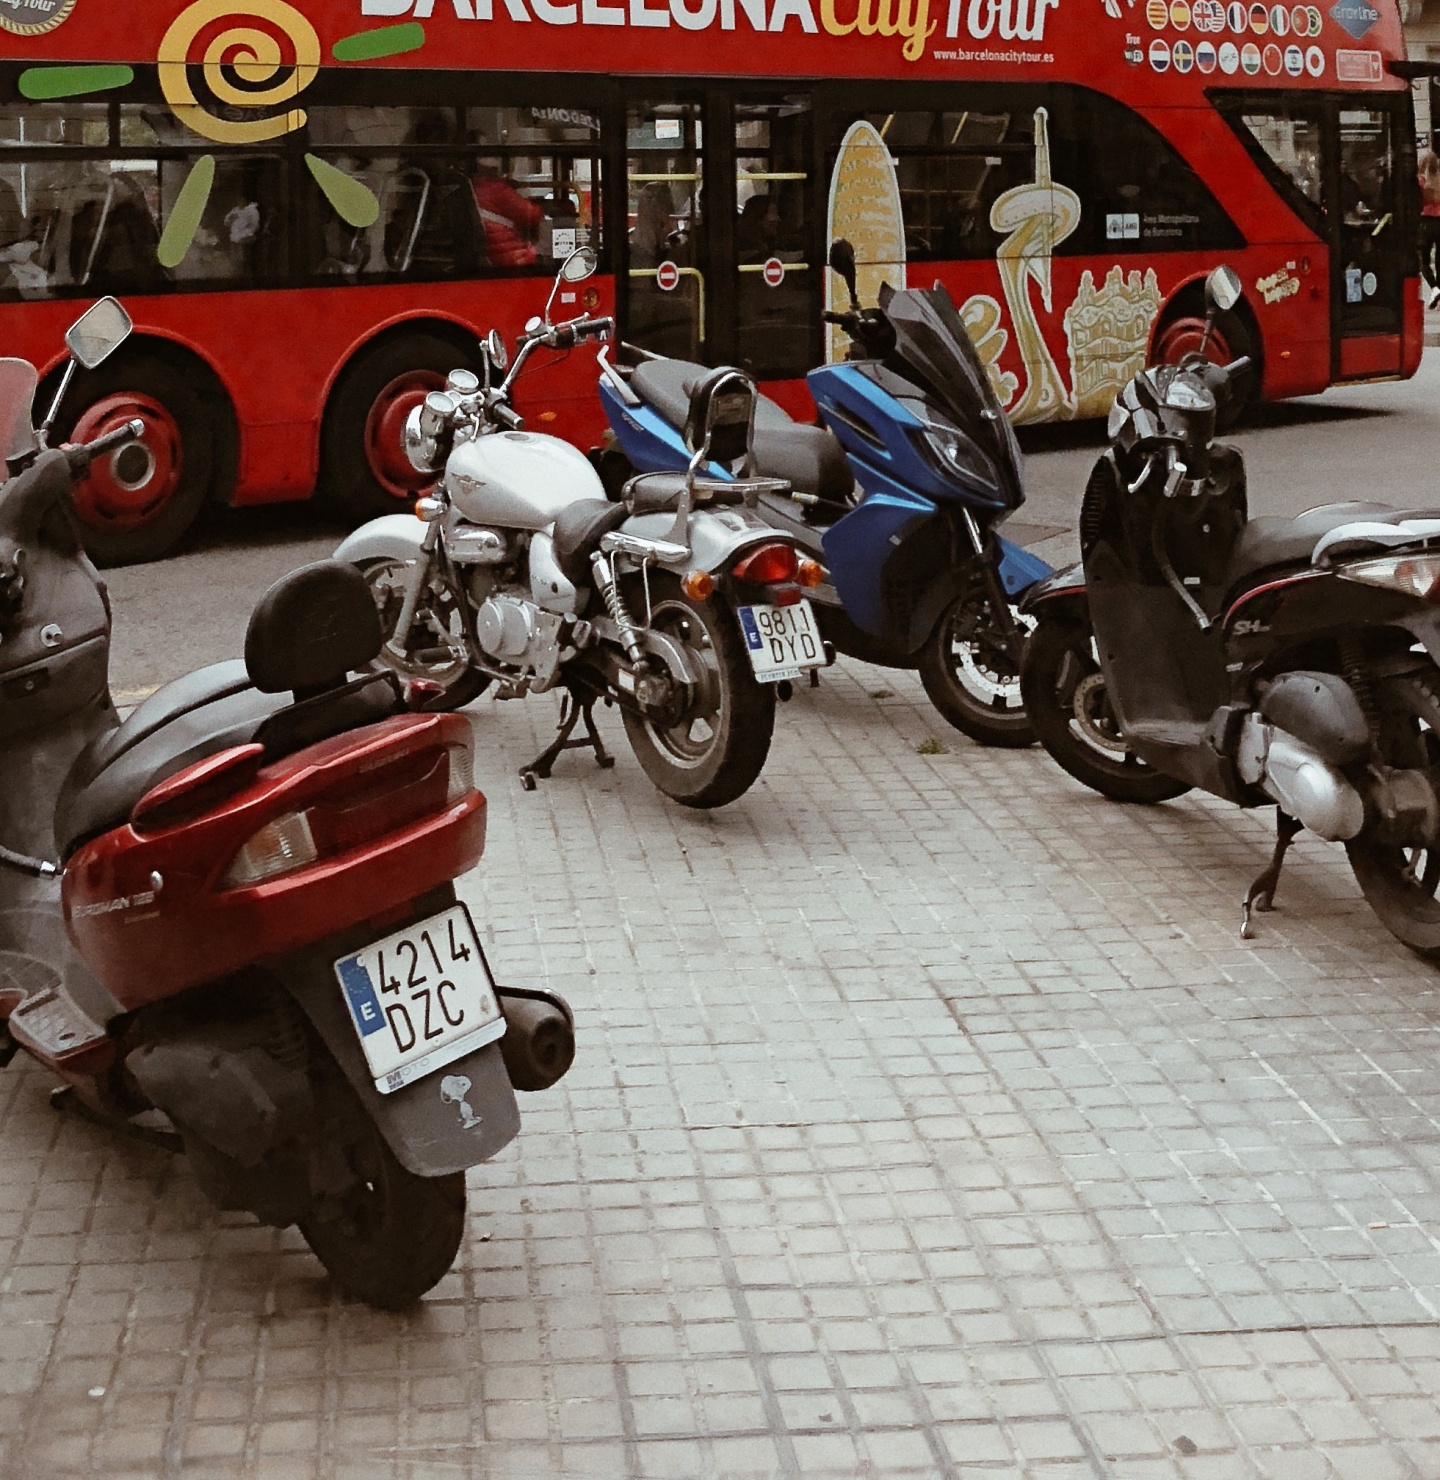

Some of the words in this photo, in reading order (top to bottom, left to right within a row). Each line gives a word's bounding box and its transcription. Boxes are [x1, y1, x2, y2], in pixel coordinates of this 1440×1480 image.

[933, 48, 1055, 65] www.barcelonacitytour.es
[759, 607, 811, 637] 9811
[749, 632, 758, 643] E
[769, 633, 816, 664] DYD
[378, 919, 471, 996] 4214
[360, 1001, 376, 1022] E
[385, 980, 465, 1054] DZC
[386, 1057, 430, 1085] MOTO
